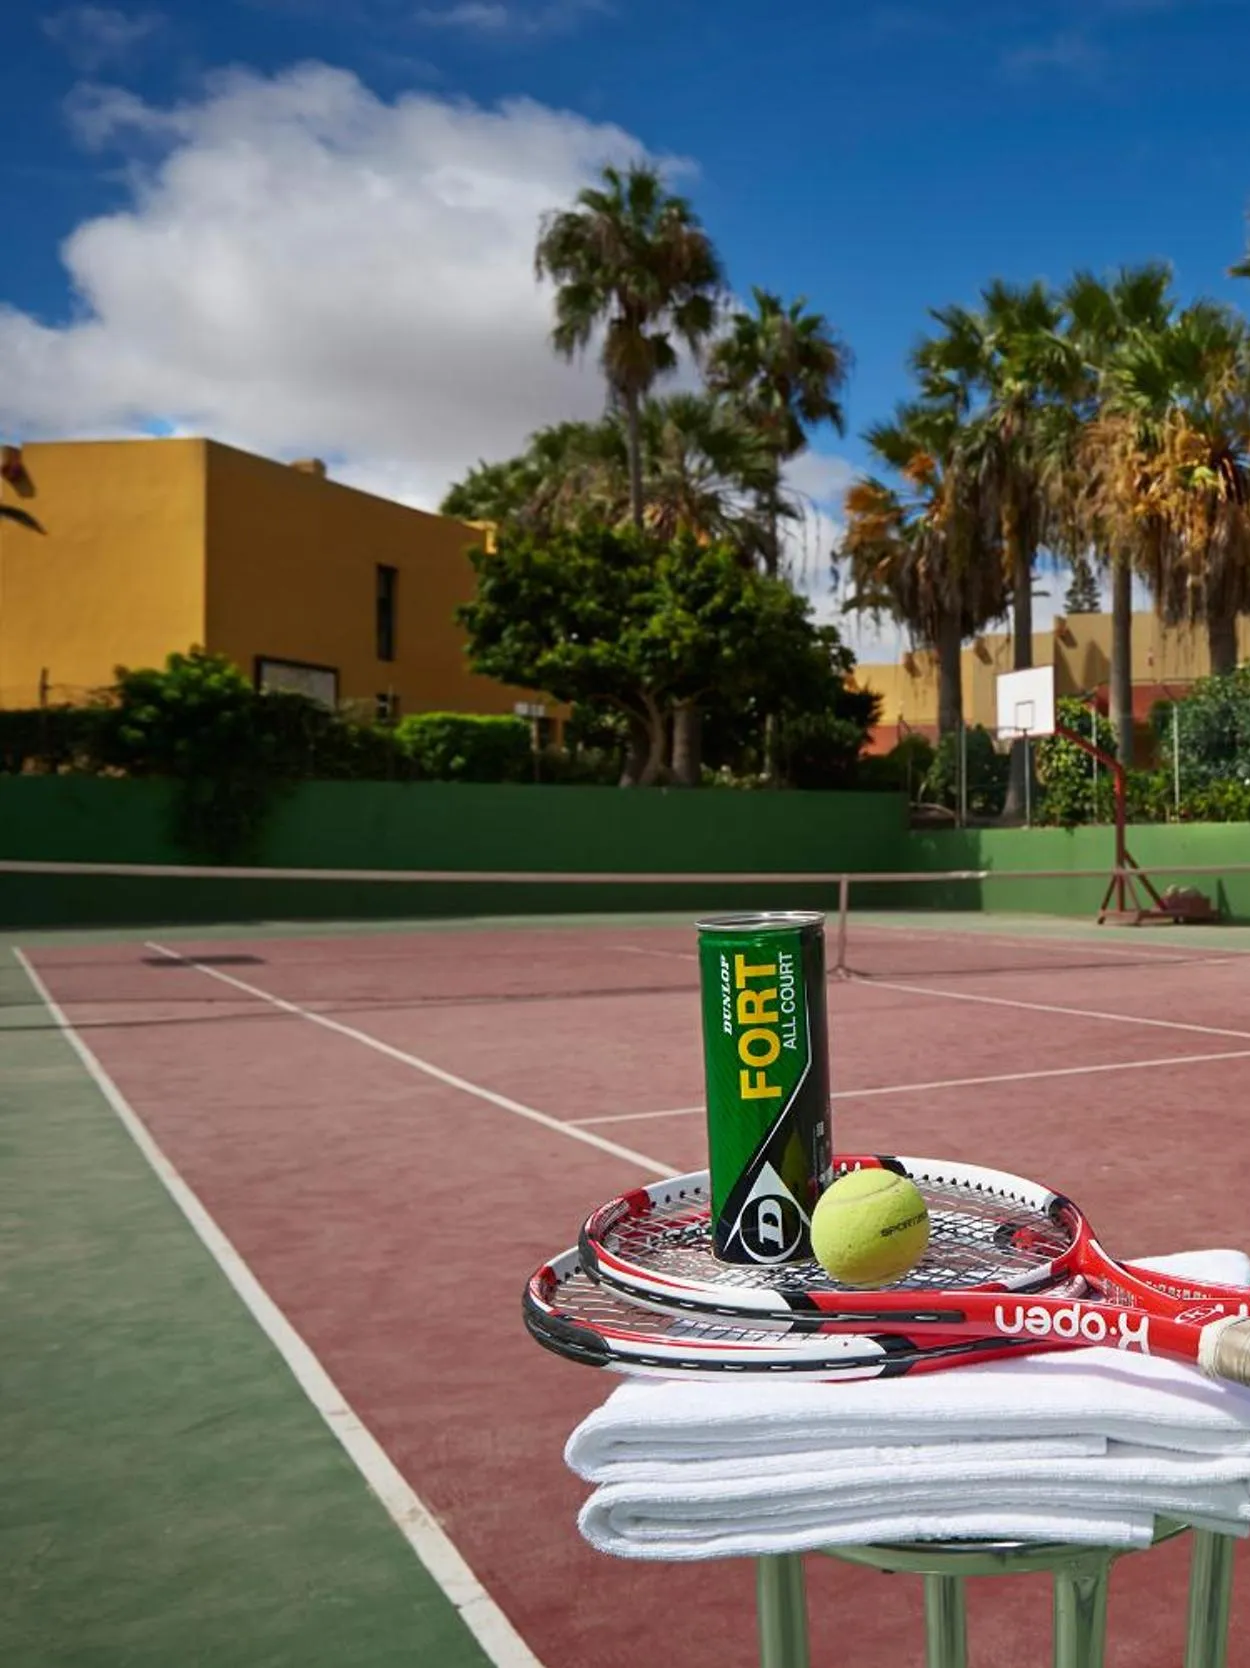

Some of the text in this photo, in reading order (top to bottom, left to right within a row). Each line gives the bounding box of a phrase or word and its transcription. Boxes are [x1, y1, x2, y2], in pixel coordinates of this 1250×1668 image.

[720, 953, 732, 1035] DUNLOP
[735, 954, 782, 1099] FORT
[779, 952, 796, 1049] ALL COURT
